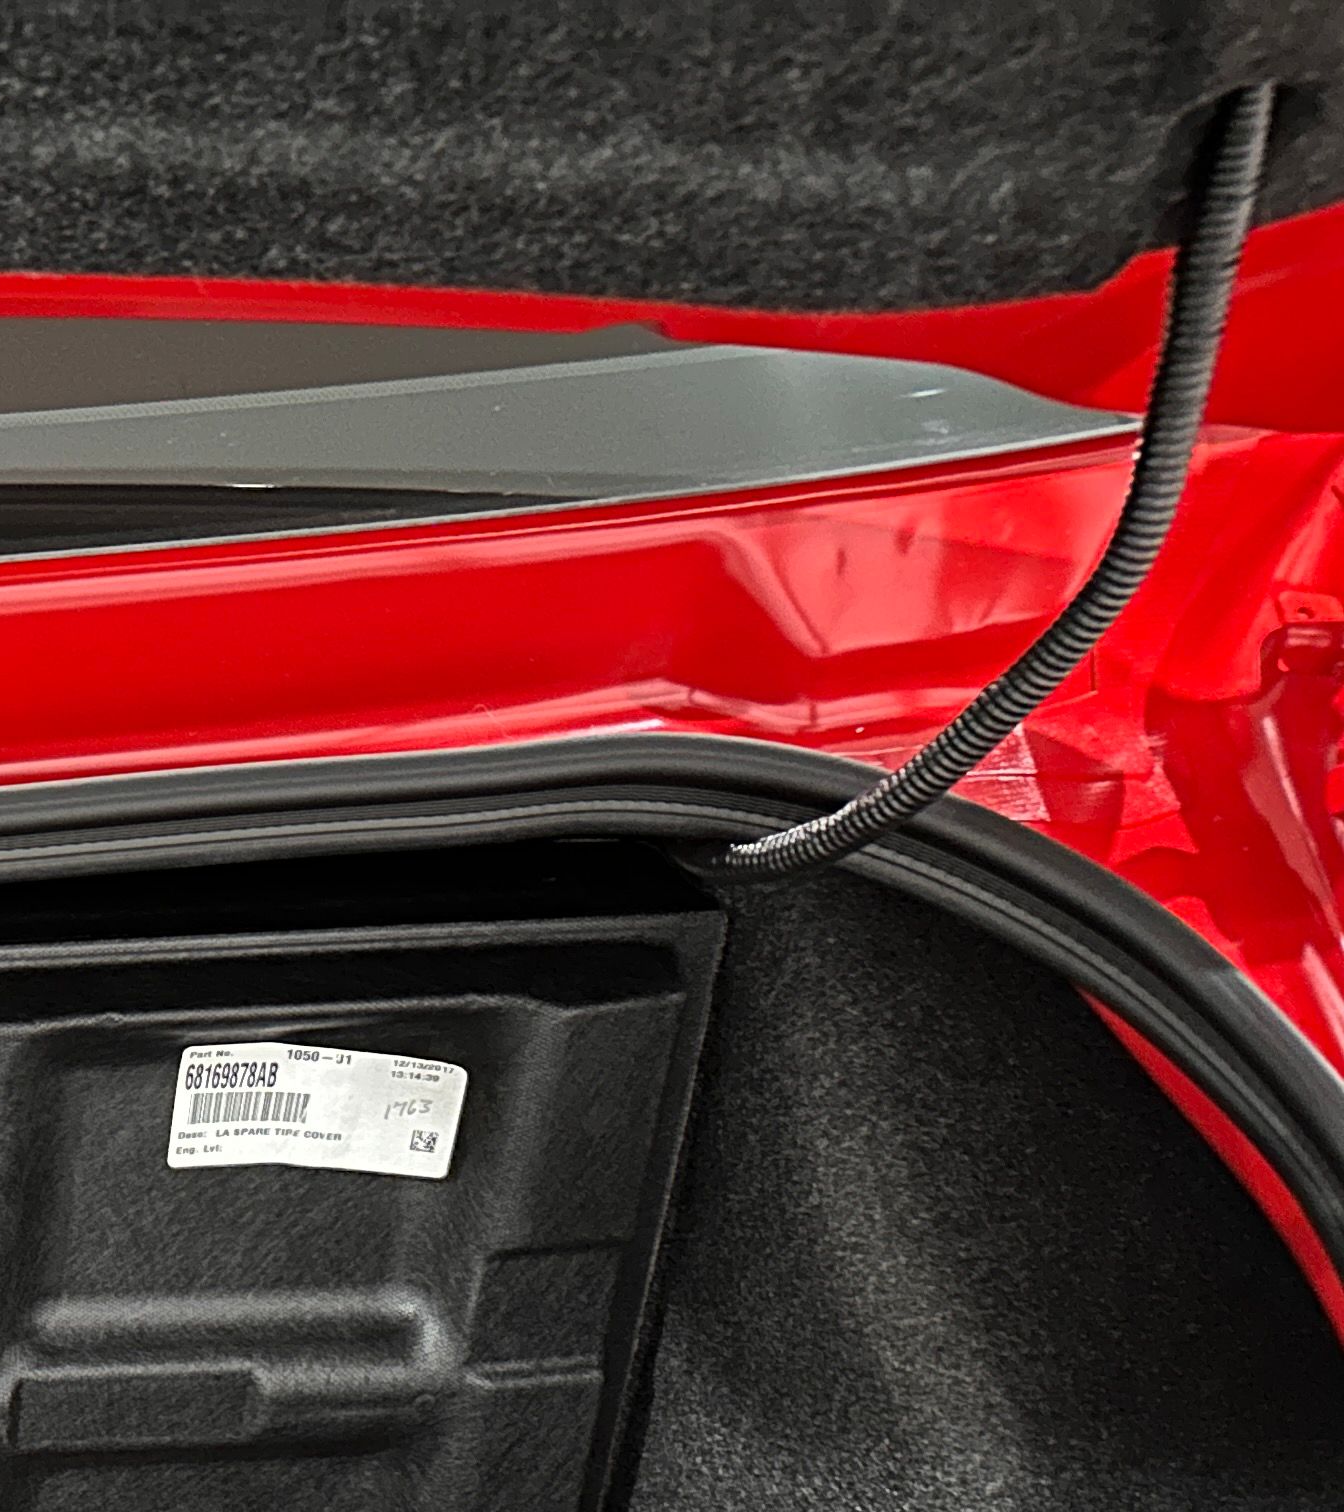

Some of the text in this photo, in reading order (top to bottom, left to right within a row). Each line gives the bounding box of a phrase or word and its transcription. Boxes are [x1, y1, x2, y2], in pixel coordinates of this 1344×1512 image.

[190, 1051, 212, 1059] Part
[185, 1062, 279, 1090] 68169878AB
[384, 1099, 433, 1120] 1763
[216, 1129, 230, 1137] LA
[234, 1128, 270, 1136] SPARE
[304, 1130, 342, 1141] COVER
[176, 1146, 199, 1155] Eng.
